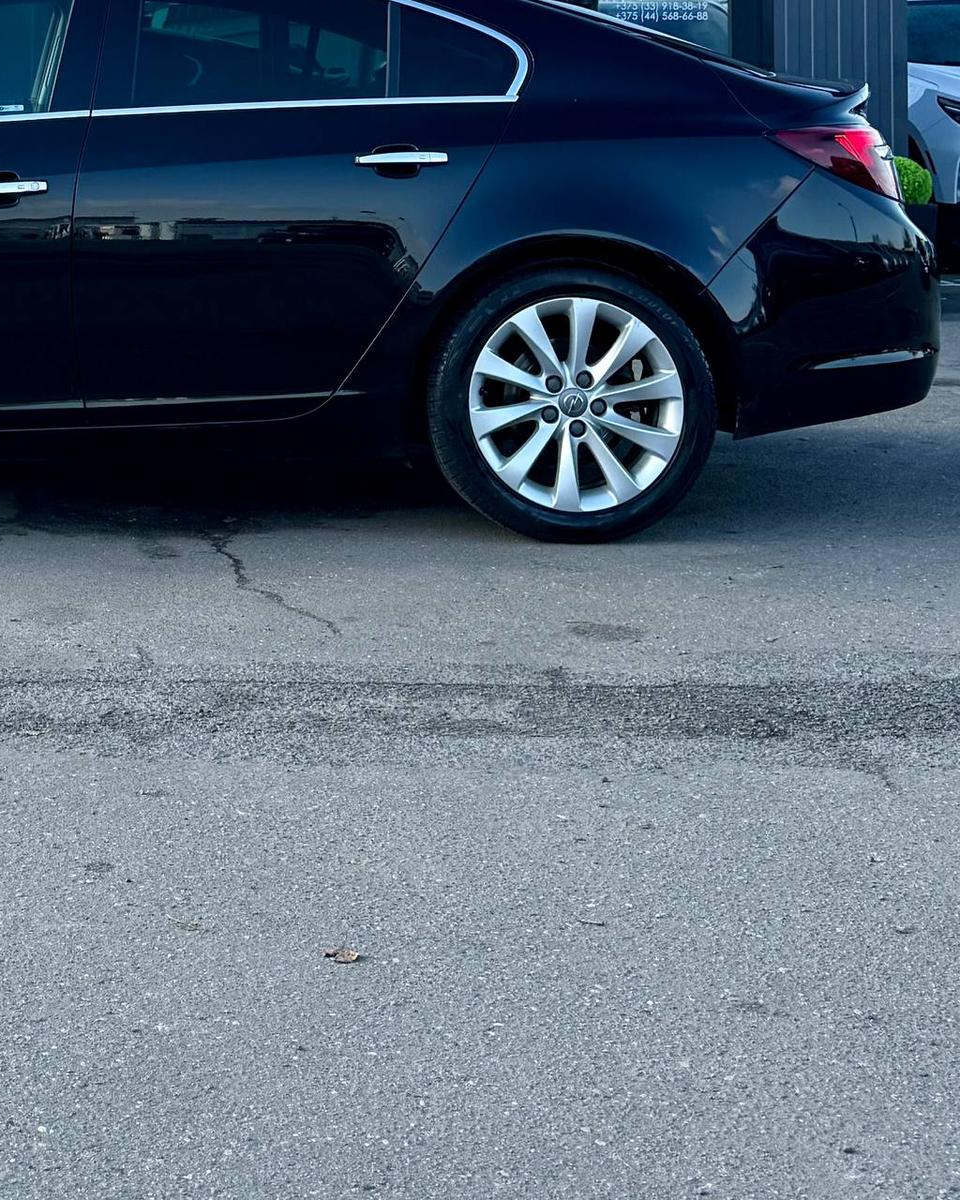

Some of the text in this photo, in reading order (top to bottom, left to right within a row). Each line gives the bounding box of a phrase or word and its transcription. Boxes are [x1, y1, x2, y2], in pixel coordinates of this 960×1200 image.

[615, 1, 708, 13] +375 (33) 918-38-19
[615, 11, 709, 23] +375 (44) 568-66-88
